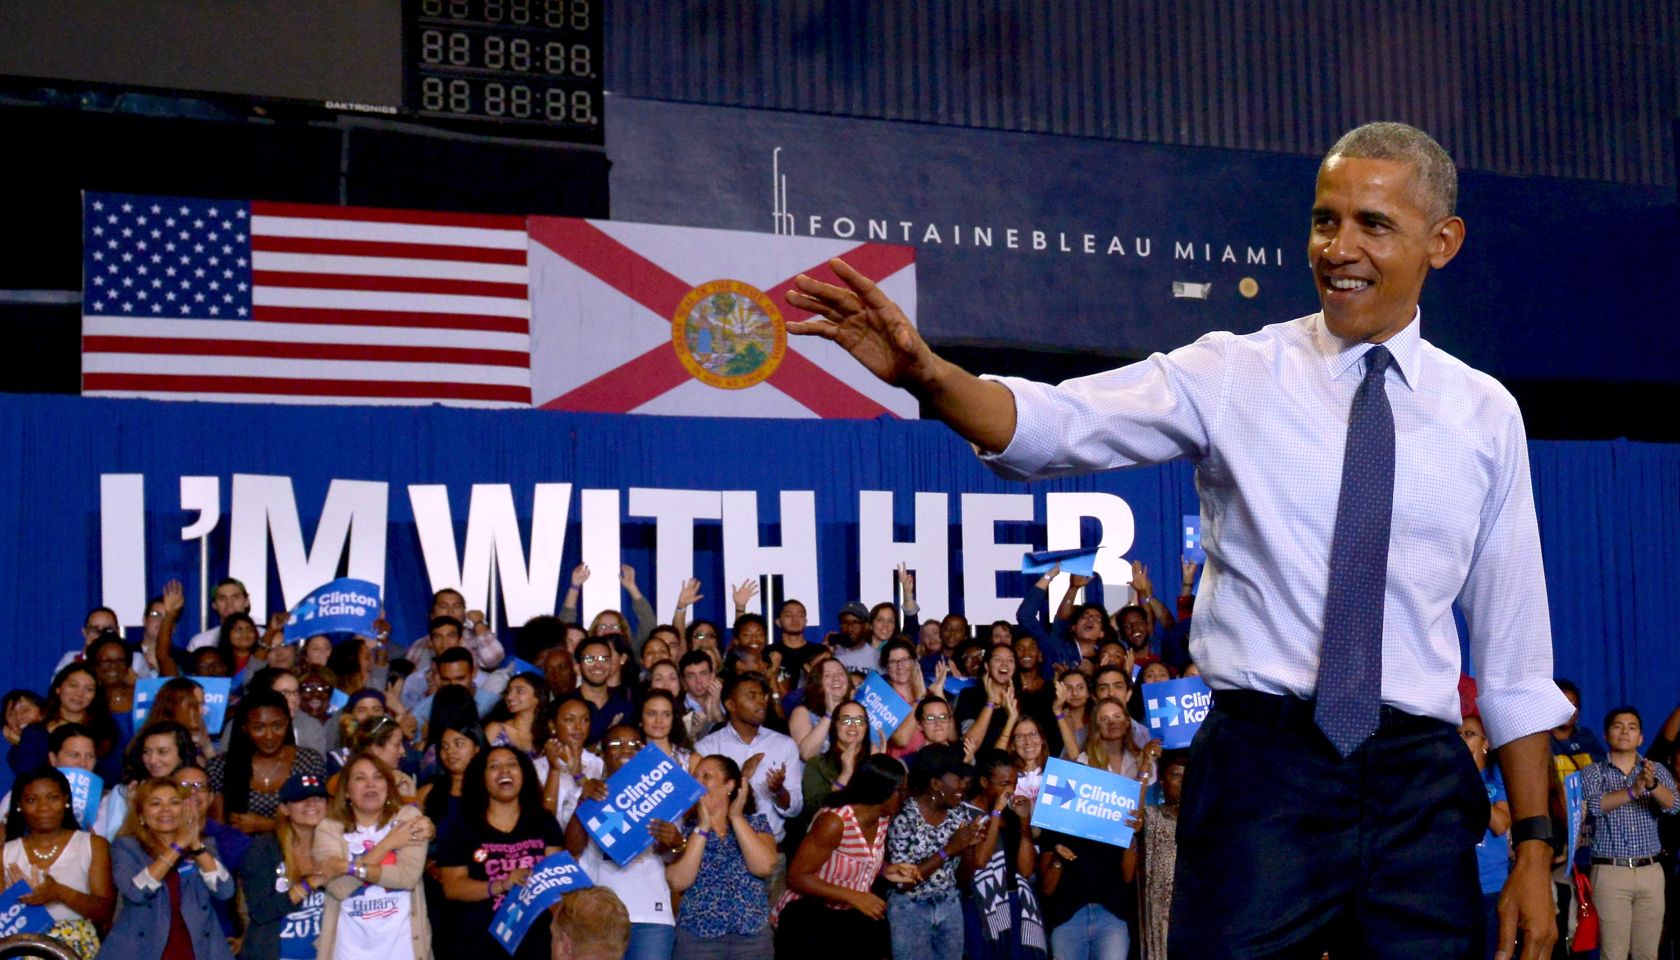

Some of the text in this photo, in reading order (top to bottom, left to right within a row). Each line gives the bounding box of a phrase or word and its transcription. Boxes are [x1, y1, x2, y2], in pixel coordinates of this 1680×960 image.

[325, 101, 398, 114] DAKTRONICS
[810, 215, 1282, 266] FONTAINEBLEAU MIAMI
[101, 473, 1134, 628] I'M WITH HER
[318, 591, 377, 608] Clinton
[319, 603, 366, 617] Kaine
[865, 691, 899, 727] Clinton
[1181, 690, 1212, 709] Clin
[1183, 706, 1209, 724] Kai
[615, 760, 674, 809] Clinton
[1079, 783, 1136, 810] Clinton
[72, 774, 90, 824] STRO
[626, 781, 675, 823] Kaine
[1075, 798, 1122, 822] Kaine
[523, 875, 573, 906] Kaine
[352, 897, 398, 912] Hillary
[280, 912, 321, 938] 201
